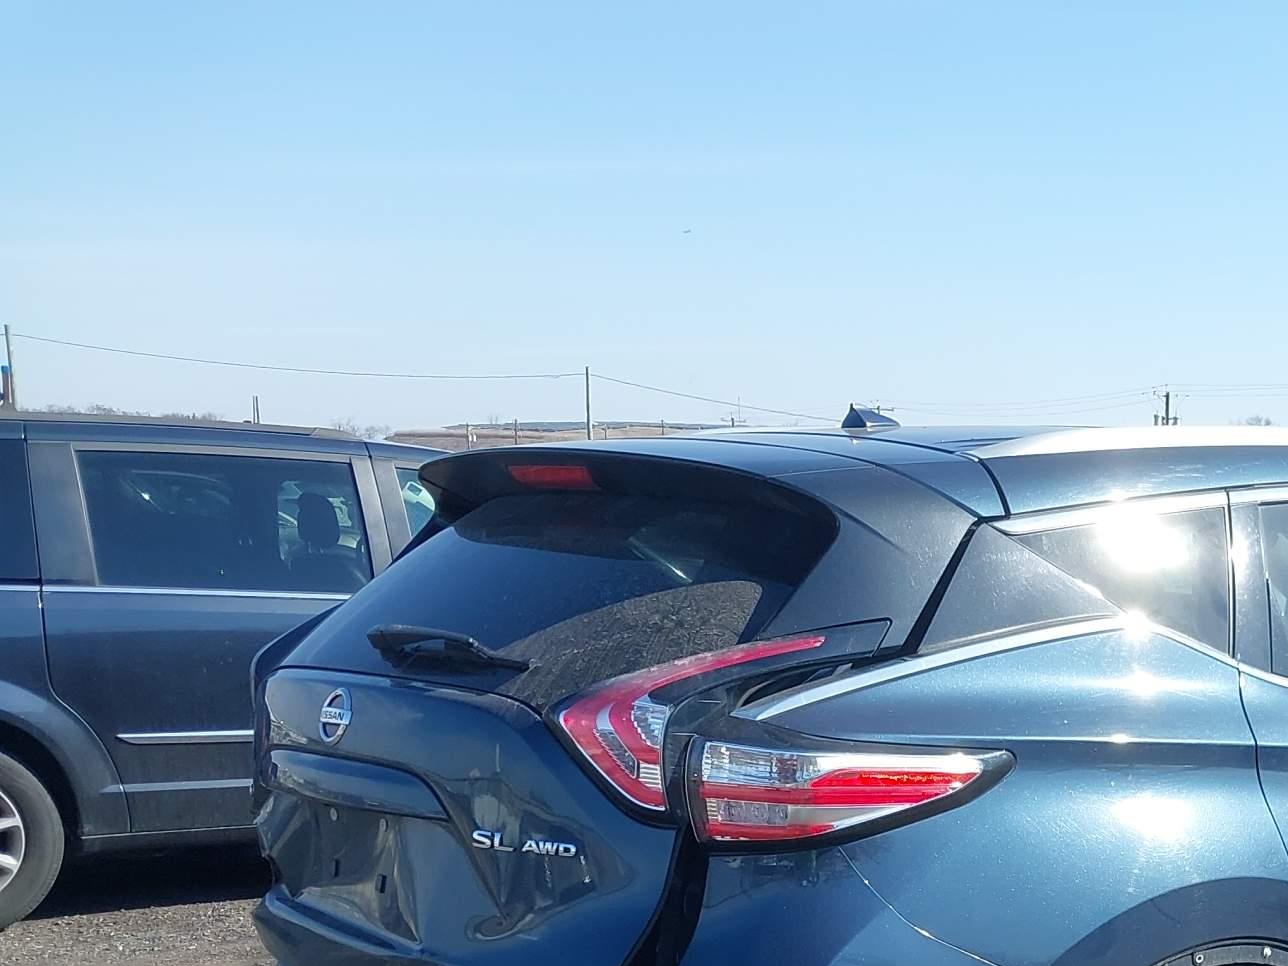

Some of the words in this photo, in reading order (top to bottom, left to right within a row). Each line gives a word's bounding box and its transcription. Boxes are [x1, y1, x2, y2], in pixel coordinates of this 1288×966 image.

[321, 710, 345, 721] ISSAN
[471, 829, 515, 852] SL
[521, 839, 577, 857] AWD
